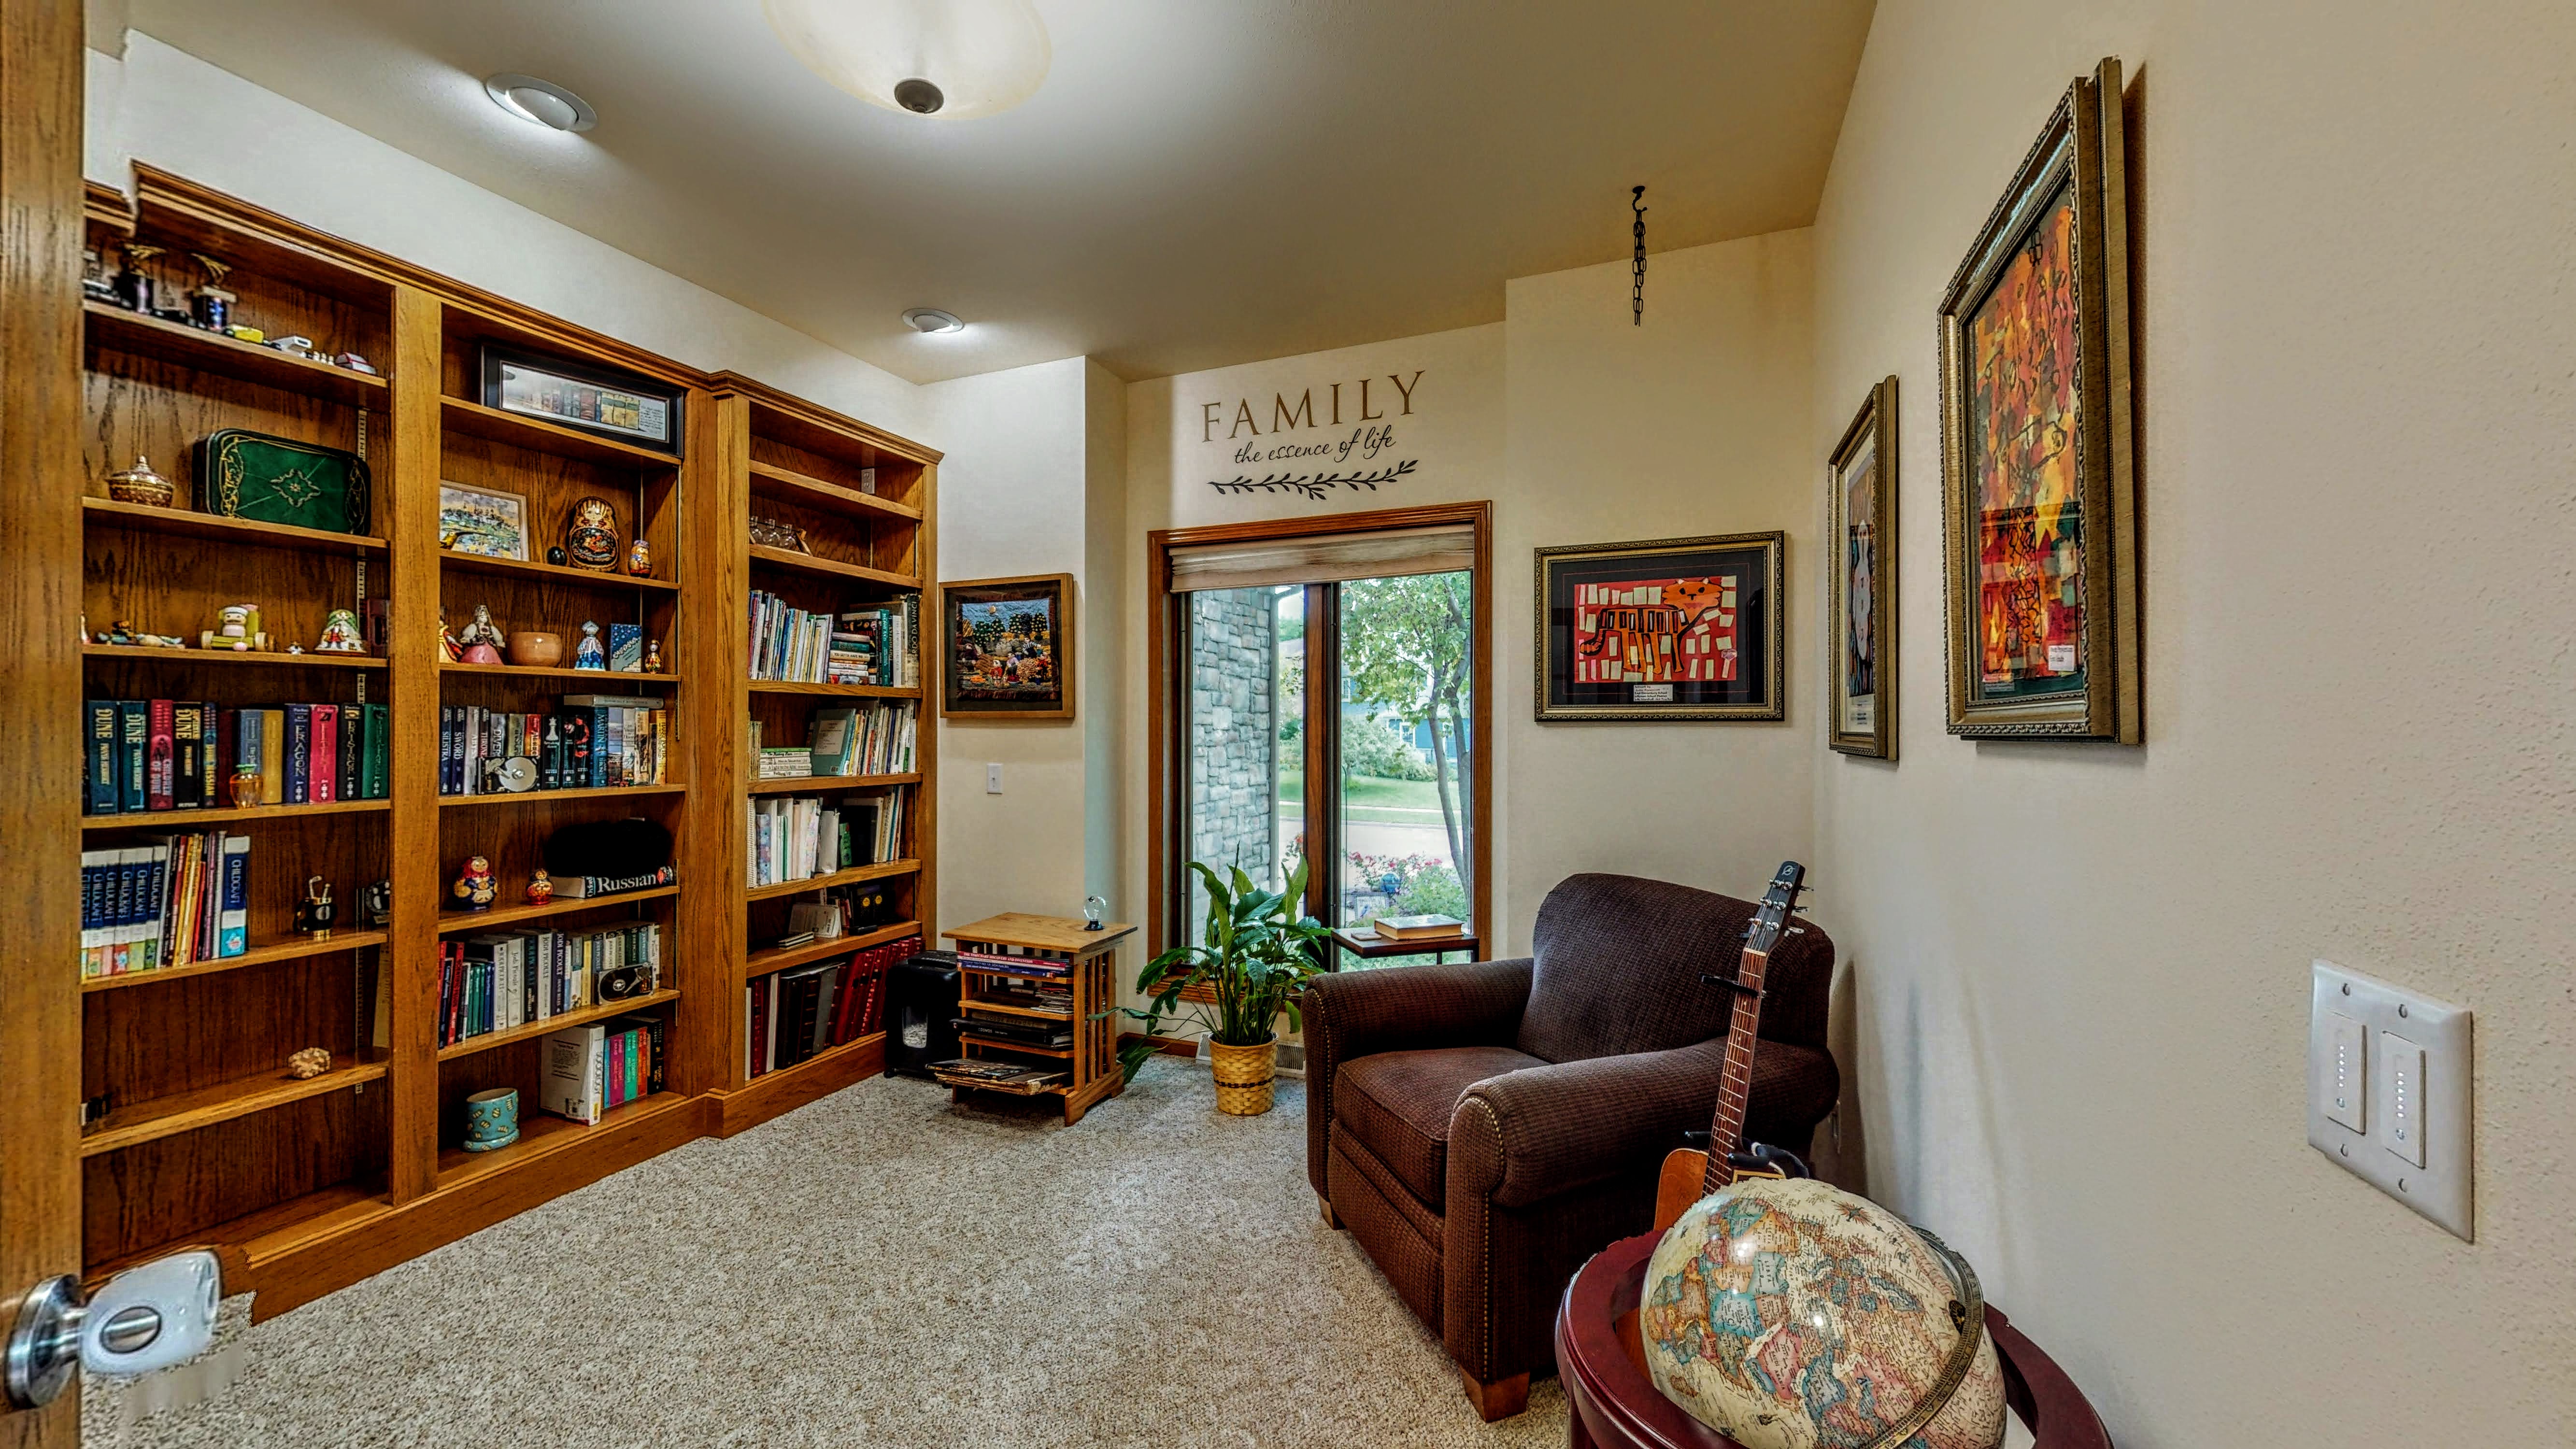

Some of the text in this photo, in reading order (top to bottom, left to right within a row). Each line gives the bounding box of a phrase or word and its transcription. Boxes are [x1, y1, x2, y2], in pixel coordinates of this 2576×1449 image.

[1201, 370, 1426, 443] FAMILY
[1234, 424, 1396, 464] the essence of life
[95, 709, 114, 739] DUNE
[126, 714, 144, 744] DUNE
[175, 709, 192, 739] DUNE
[294, 725, 305, 777] ERAGON
[453, 731, 461, 760] SWORD
[91, 873, 104, 922] CHILDCRAFT
[103, 872, 116, 919] CHILDCRAFT
[117, 871, 132, 919] CHILDCRAFT
[134, 869, 147, 916] CHILDCRAFT
[149, 867, 164, 913] CHILDCRAFT
[230, 859, 242, 904] CHILDCRAFT
[596, 873, 656, 893] Russian
[542, 936, 550, 952] JODI
[556, 933, 565, 948] JODI
[1771, 1350, 1786, 1390] SAUDI ARABIA
